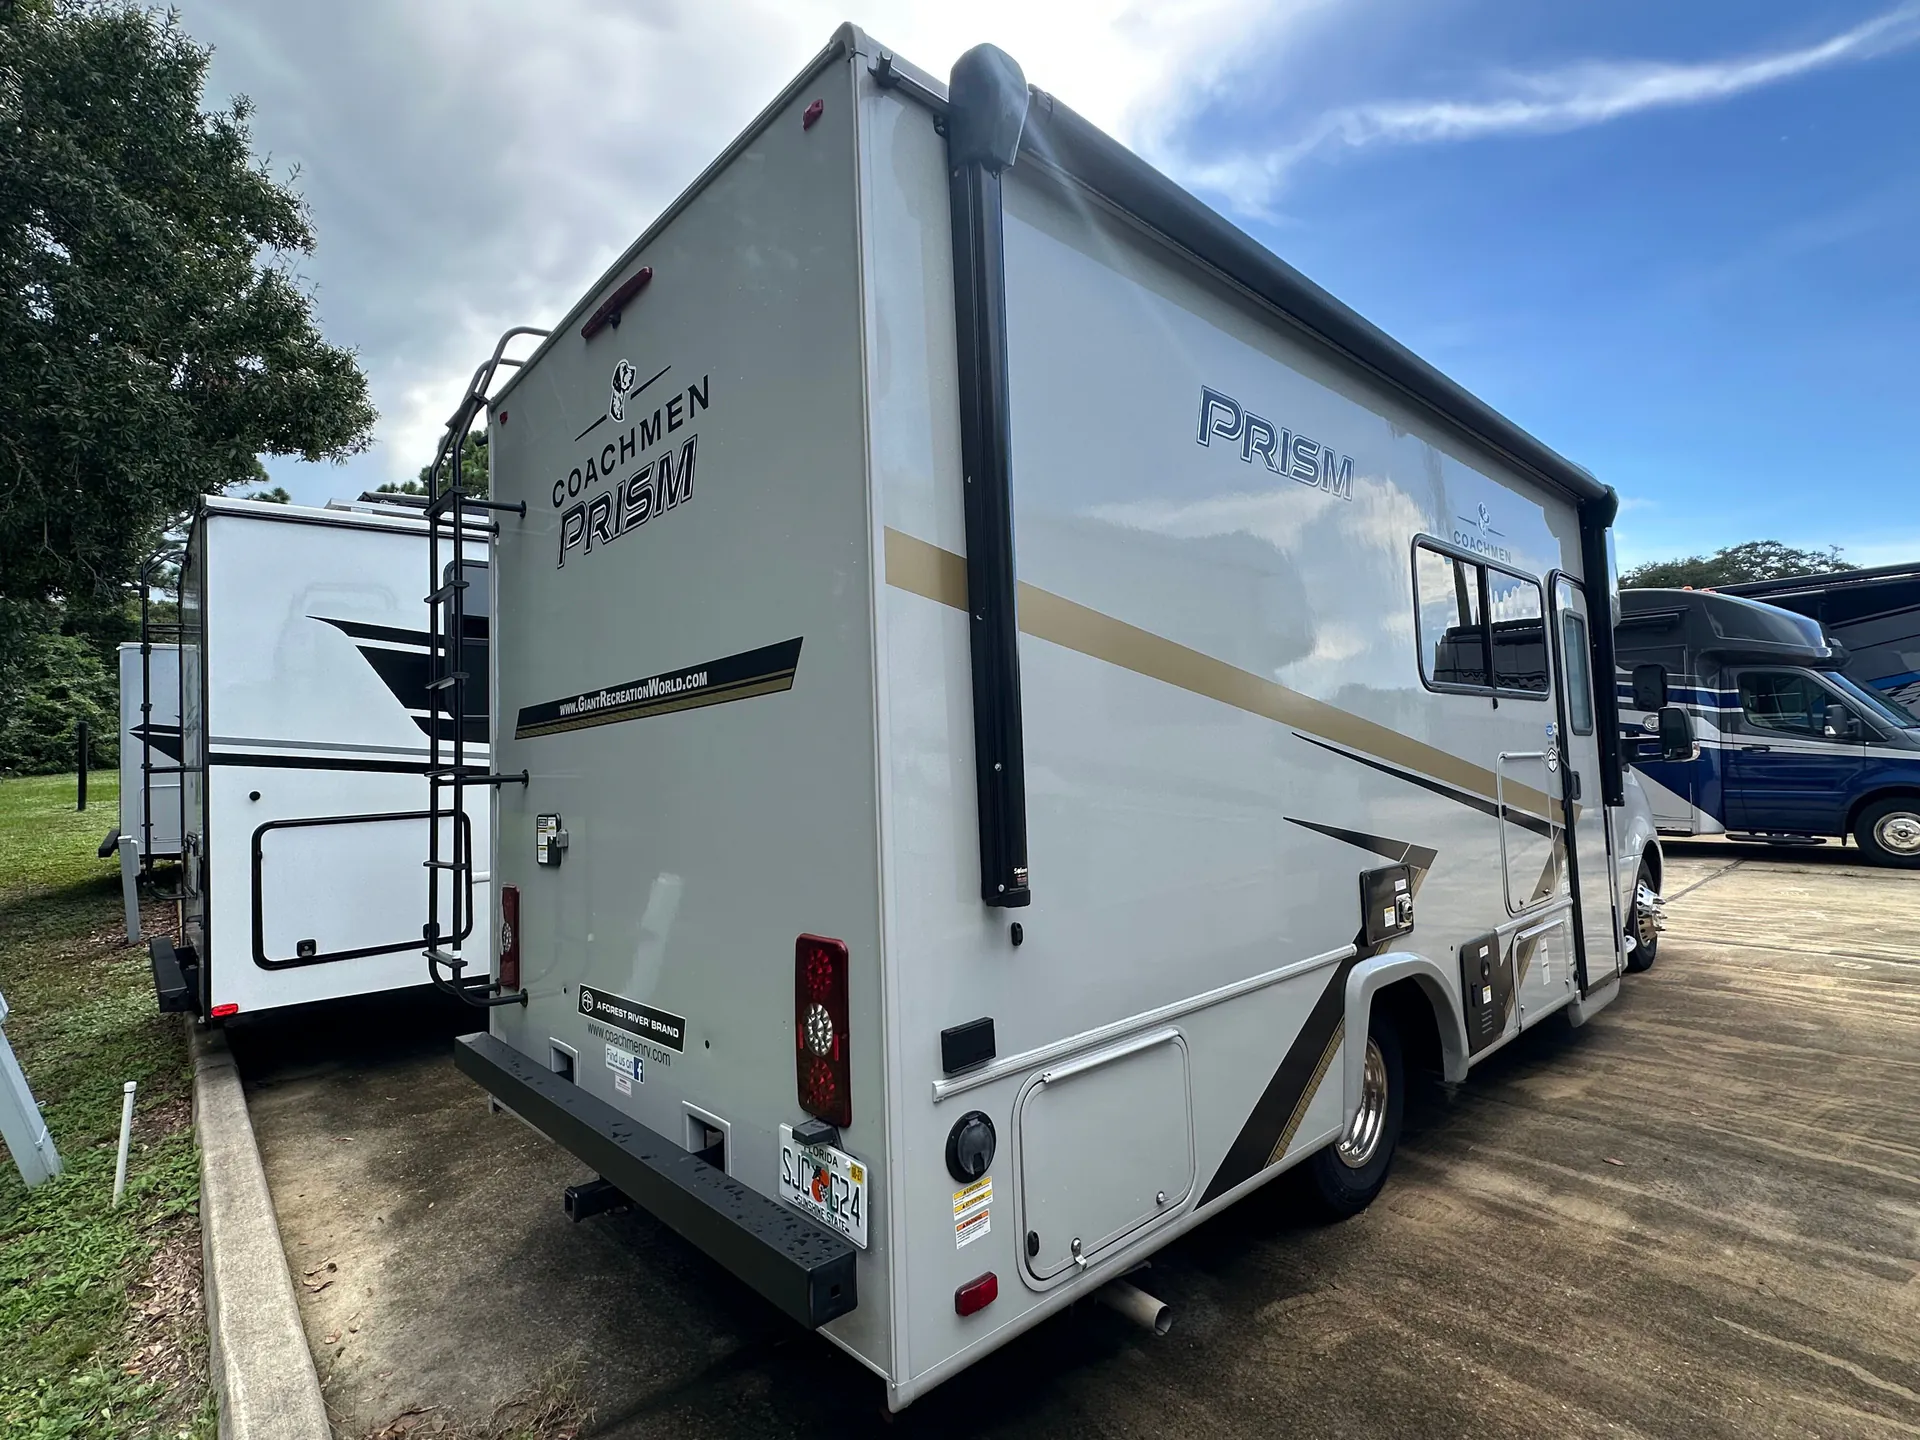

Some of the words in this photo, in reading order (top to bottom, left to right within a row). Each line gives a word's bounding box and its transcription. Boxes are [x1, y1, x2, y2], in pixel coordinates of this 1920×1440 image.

[552, 374, 709, 508] COACHMEN
[1196, 385, 1354, 501] PRISM
[557, 433, 698, 570] PRISM
[1454, 530, 1512, 564] COACHMEN
[596, 1001, 602, 1011] A
[602, 1003, 627, 1019] FOREST
[627, 1011, 650, 1027] RIVER
[651, 1020, 679, 1039] BRAND
[587, 1022, 671, 1067] www.coachmenrv.com
[606, 1048, 618, 1063] Find
[618, 1055, 626, 1067] us
[626, 1058, 634, 1071] on
[803, 1145, 839, 1168] FLORIDA
[826, 1210, 847, 1231] STATE
